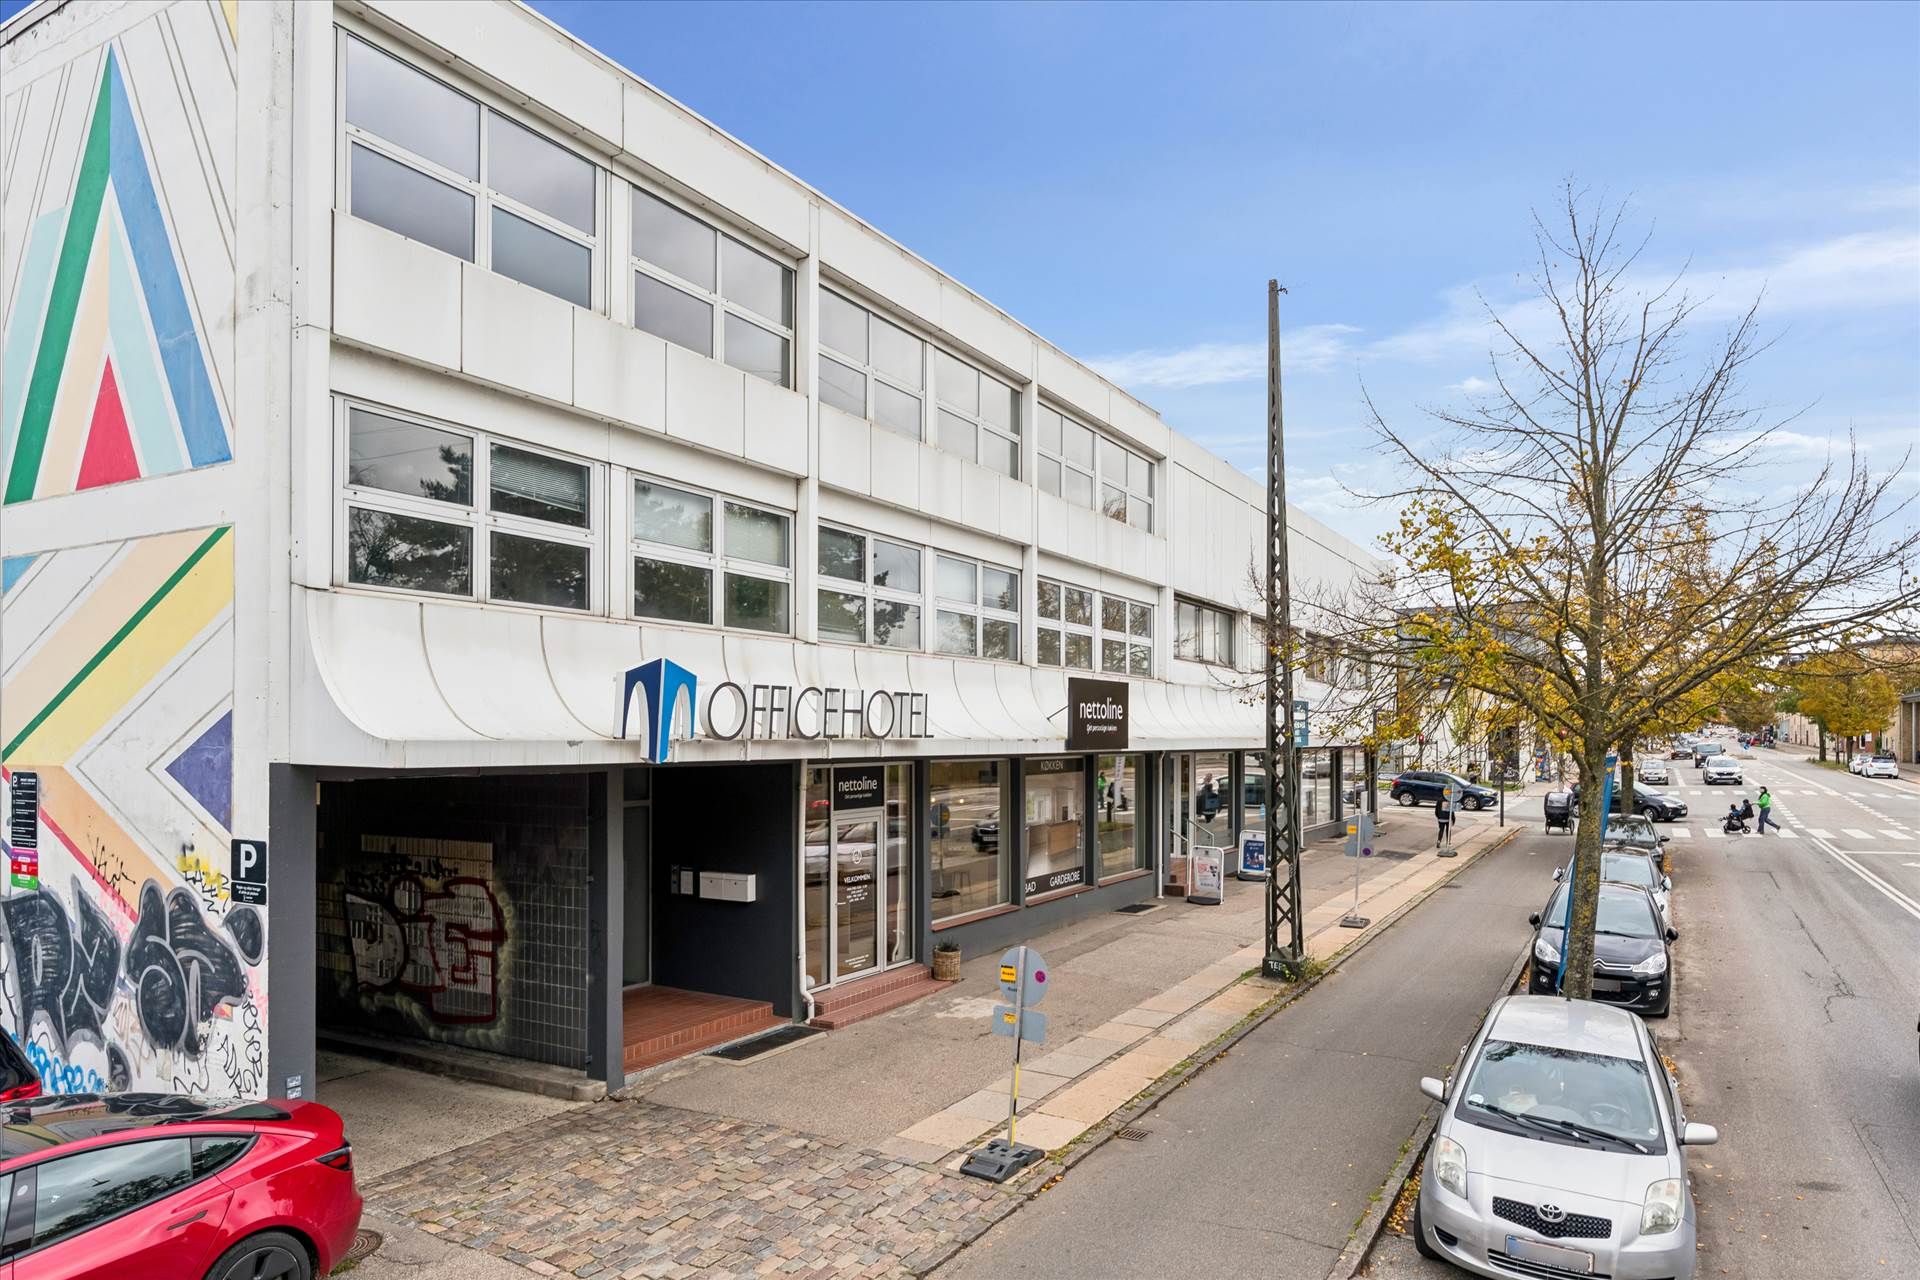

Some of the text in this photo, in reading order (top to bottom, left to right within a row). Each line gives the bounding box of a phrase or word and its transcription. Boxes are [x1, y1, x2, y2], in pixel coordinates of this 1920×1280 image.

[705, 681, 934, 741] OFFICEHOTEL
[1079, 697, 1123, 720] nettoline
[1040, 760, 1064, 771] KØKKEN
[838, 776, 878, 792] nettoline
[240, 843, 257, 878] P
[843, 873, 871, 884] VELKOMMEN
[1049, 870, 1081, 887] GARDEROBE
